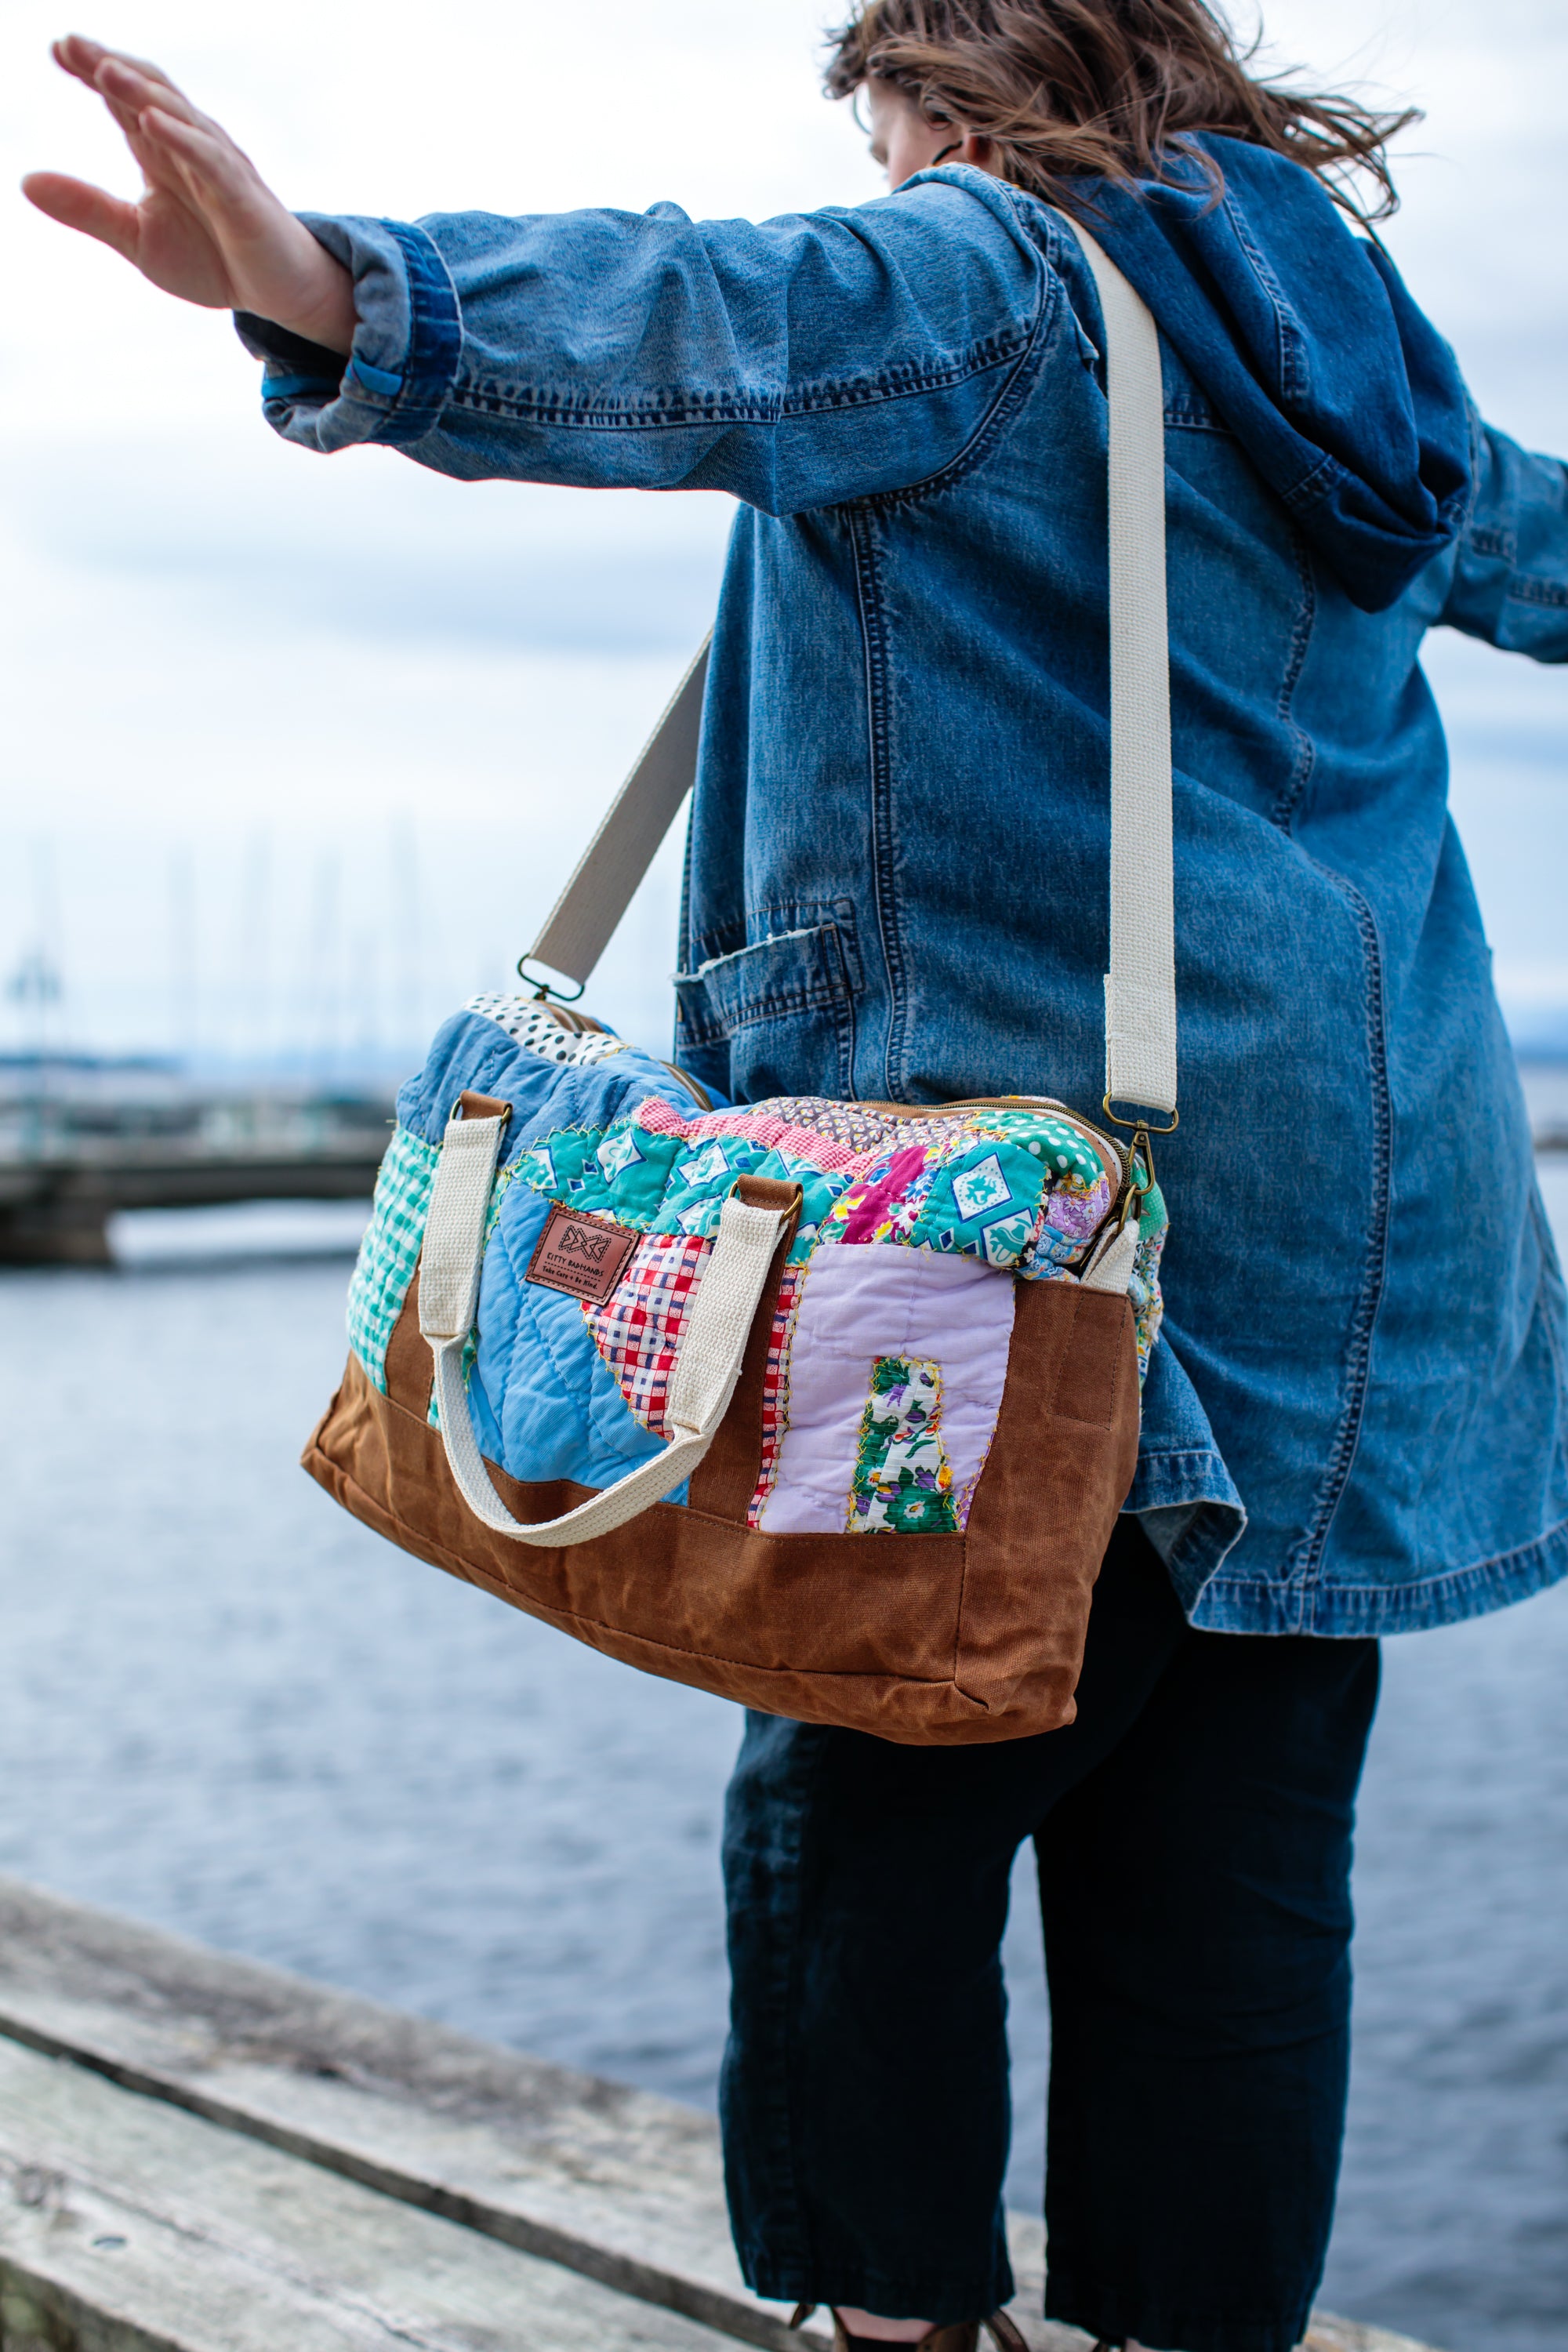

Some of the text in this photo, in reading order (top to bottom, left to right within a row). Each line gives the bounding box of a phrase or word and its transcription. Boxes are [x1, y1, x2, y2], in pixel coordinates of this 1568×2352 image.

[543, 1265, 555, 1275] Take
[556, 1270, 568, 1279] Care
[546, 1252, 604, 1277] KITTY BADHANDS
